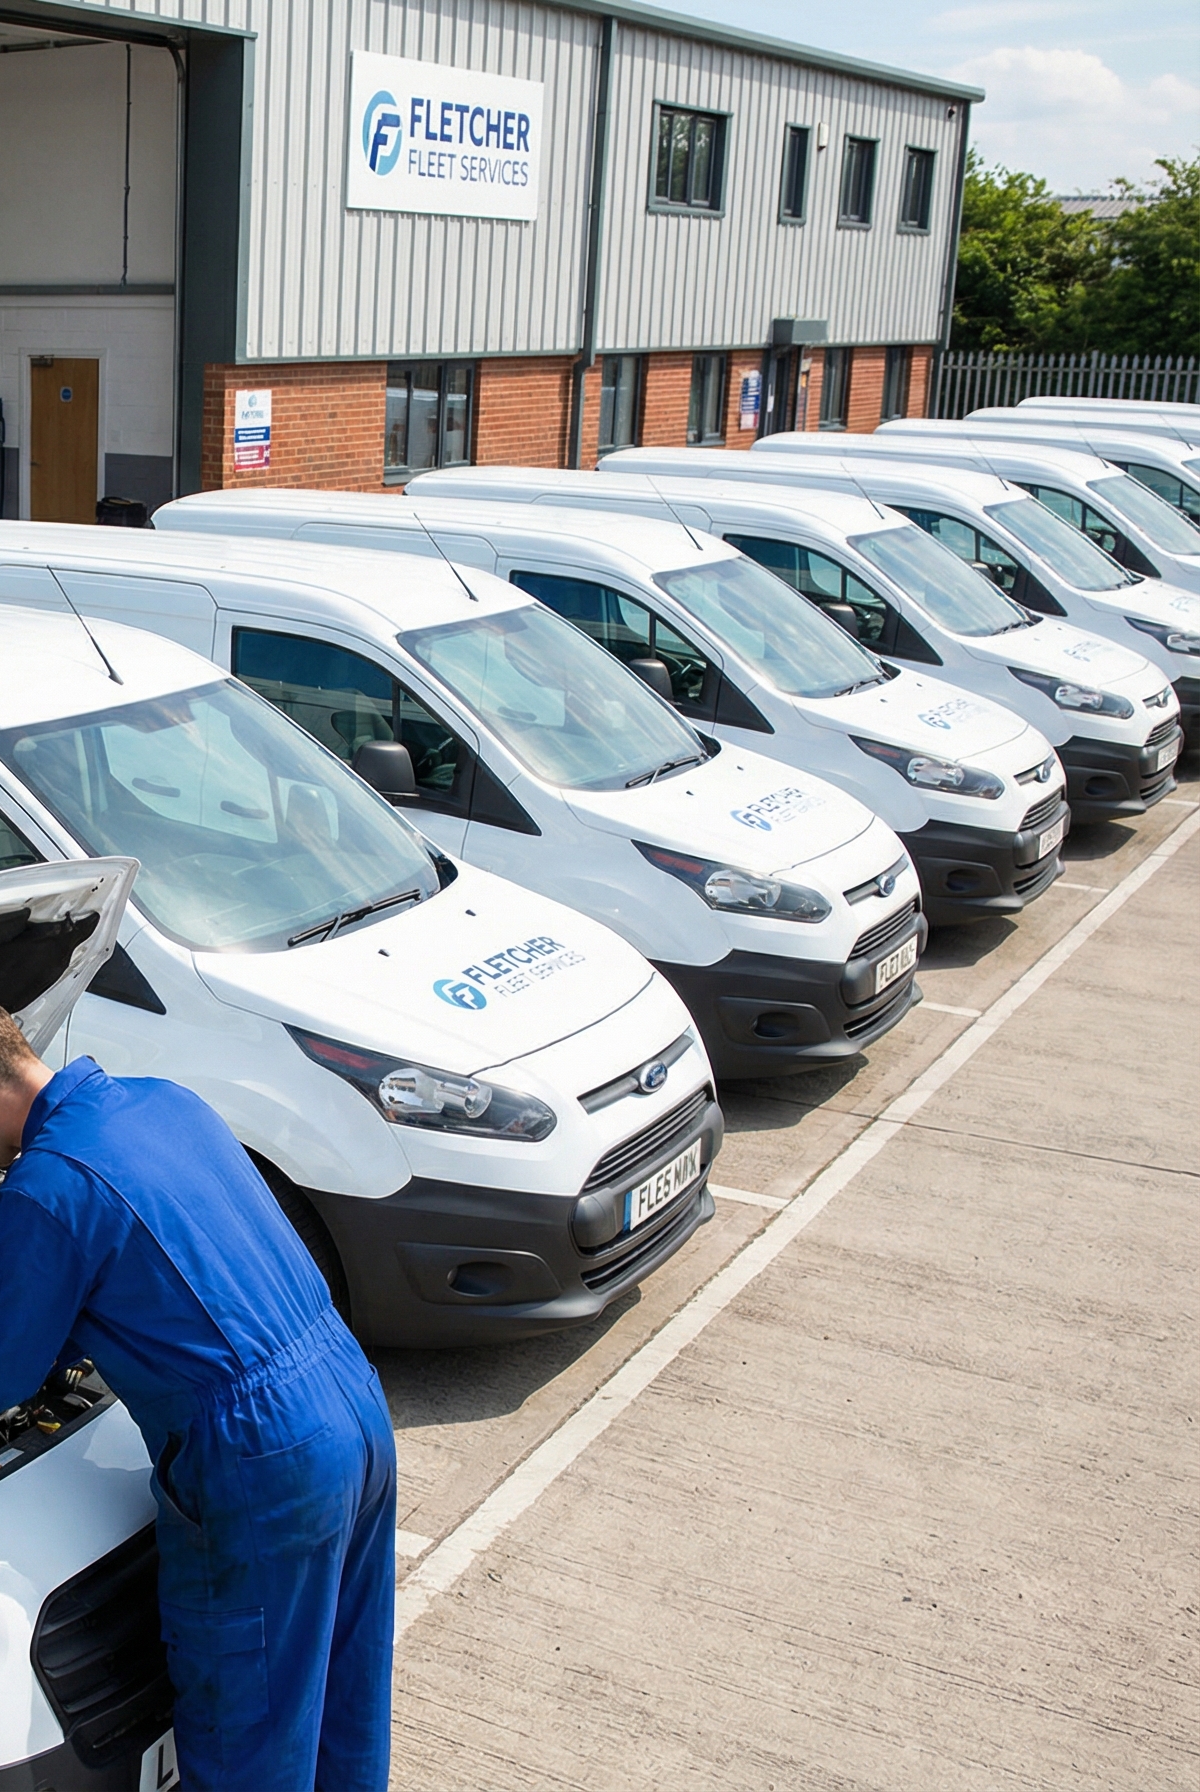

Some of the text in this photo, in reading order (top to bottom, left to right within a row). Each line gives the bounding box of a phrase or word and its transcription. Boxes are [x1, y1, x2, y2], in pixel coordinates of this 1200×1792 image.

[409, 97, 530, 152] FLETCHER
[408, 149, 529, 187] FLEET SERVICES
[461, 936, 566, 986] FLETCHER
